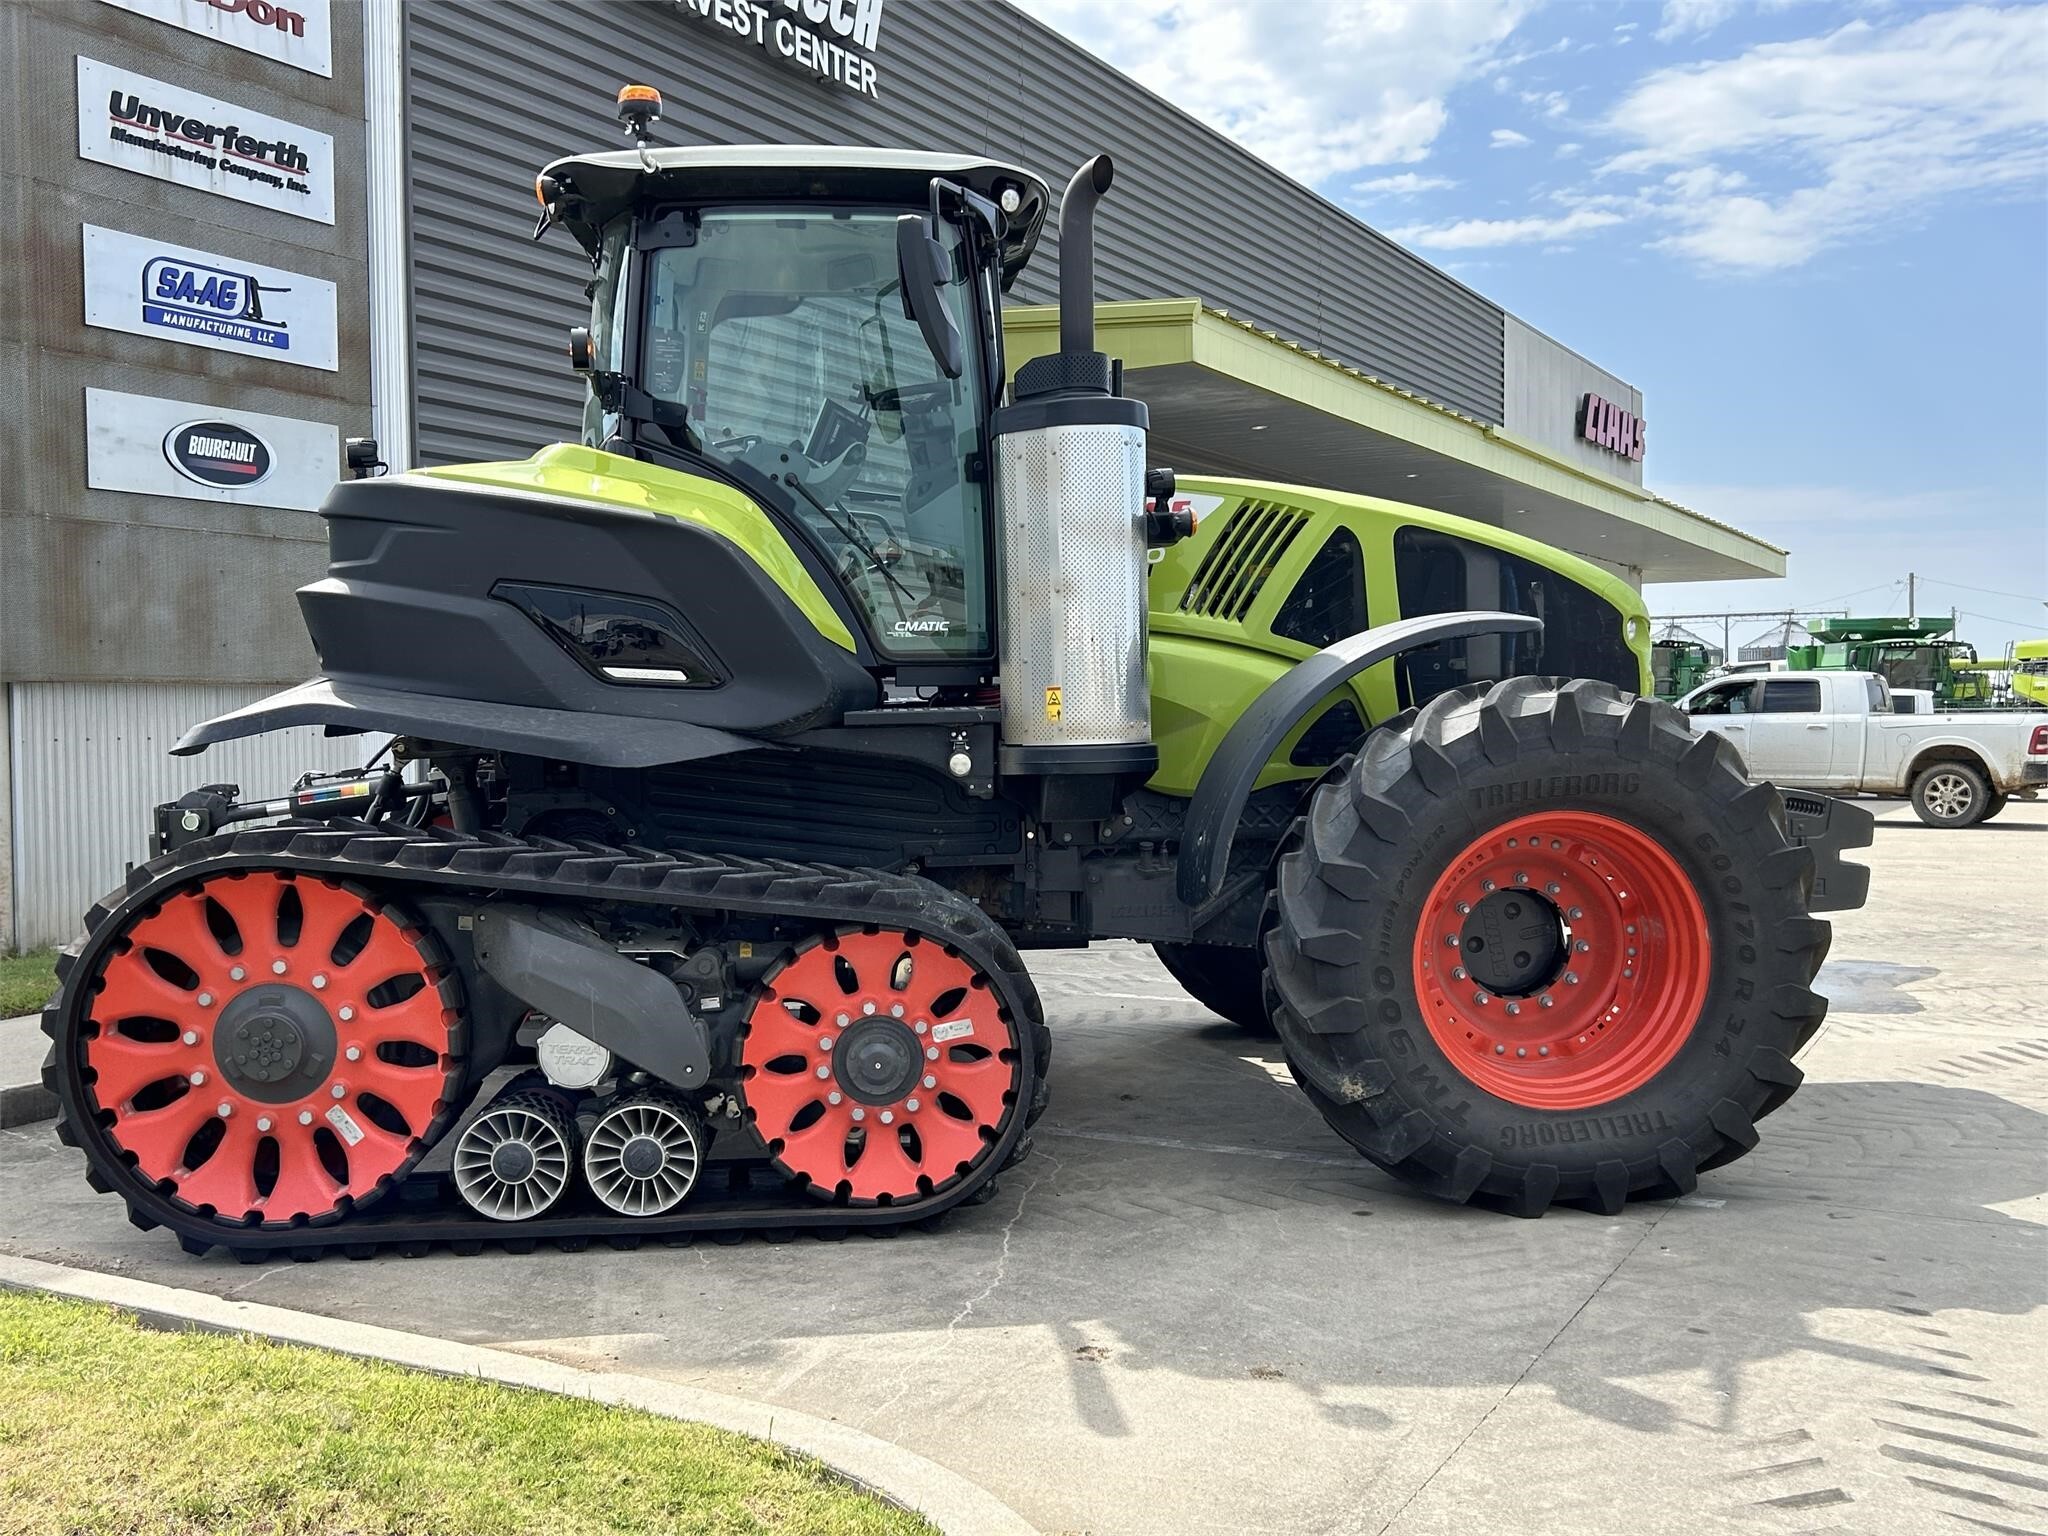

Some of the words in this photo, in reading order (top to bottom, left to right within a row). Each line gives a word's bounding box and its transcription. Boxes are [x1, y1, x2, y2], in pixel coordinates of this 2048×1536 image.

[775, 18, 879, 99] CENTER
[109, 90, 309, 173] Unverferth
[110, 126, 217, 170] Manufacturing
[219, 158, 284, 189] Company,
[286, 177, 311, 195] Inc.
[162, 312, 253, 341] MANUFACTURING,
[257, 330, 276, 344] LLC
[1583, 392, 1647, 463] CLAAS
[188, 435, 257, 463] BOURGAULT
[895, 621, 950, 632] CMATIC
[1469, 772, 1640, 809] TRELLEBORG
[547, 1043, 600, 1055] TERRA
[553, 1055, 597, 1066] TRAC
[1499, 1110, 1673, 1150] TRELLEBORG
